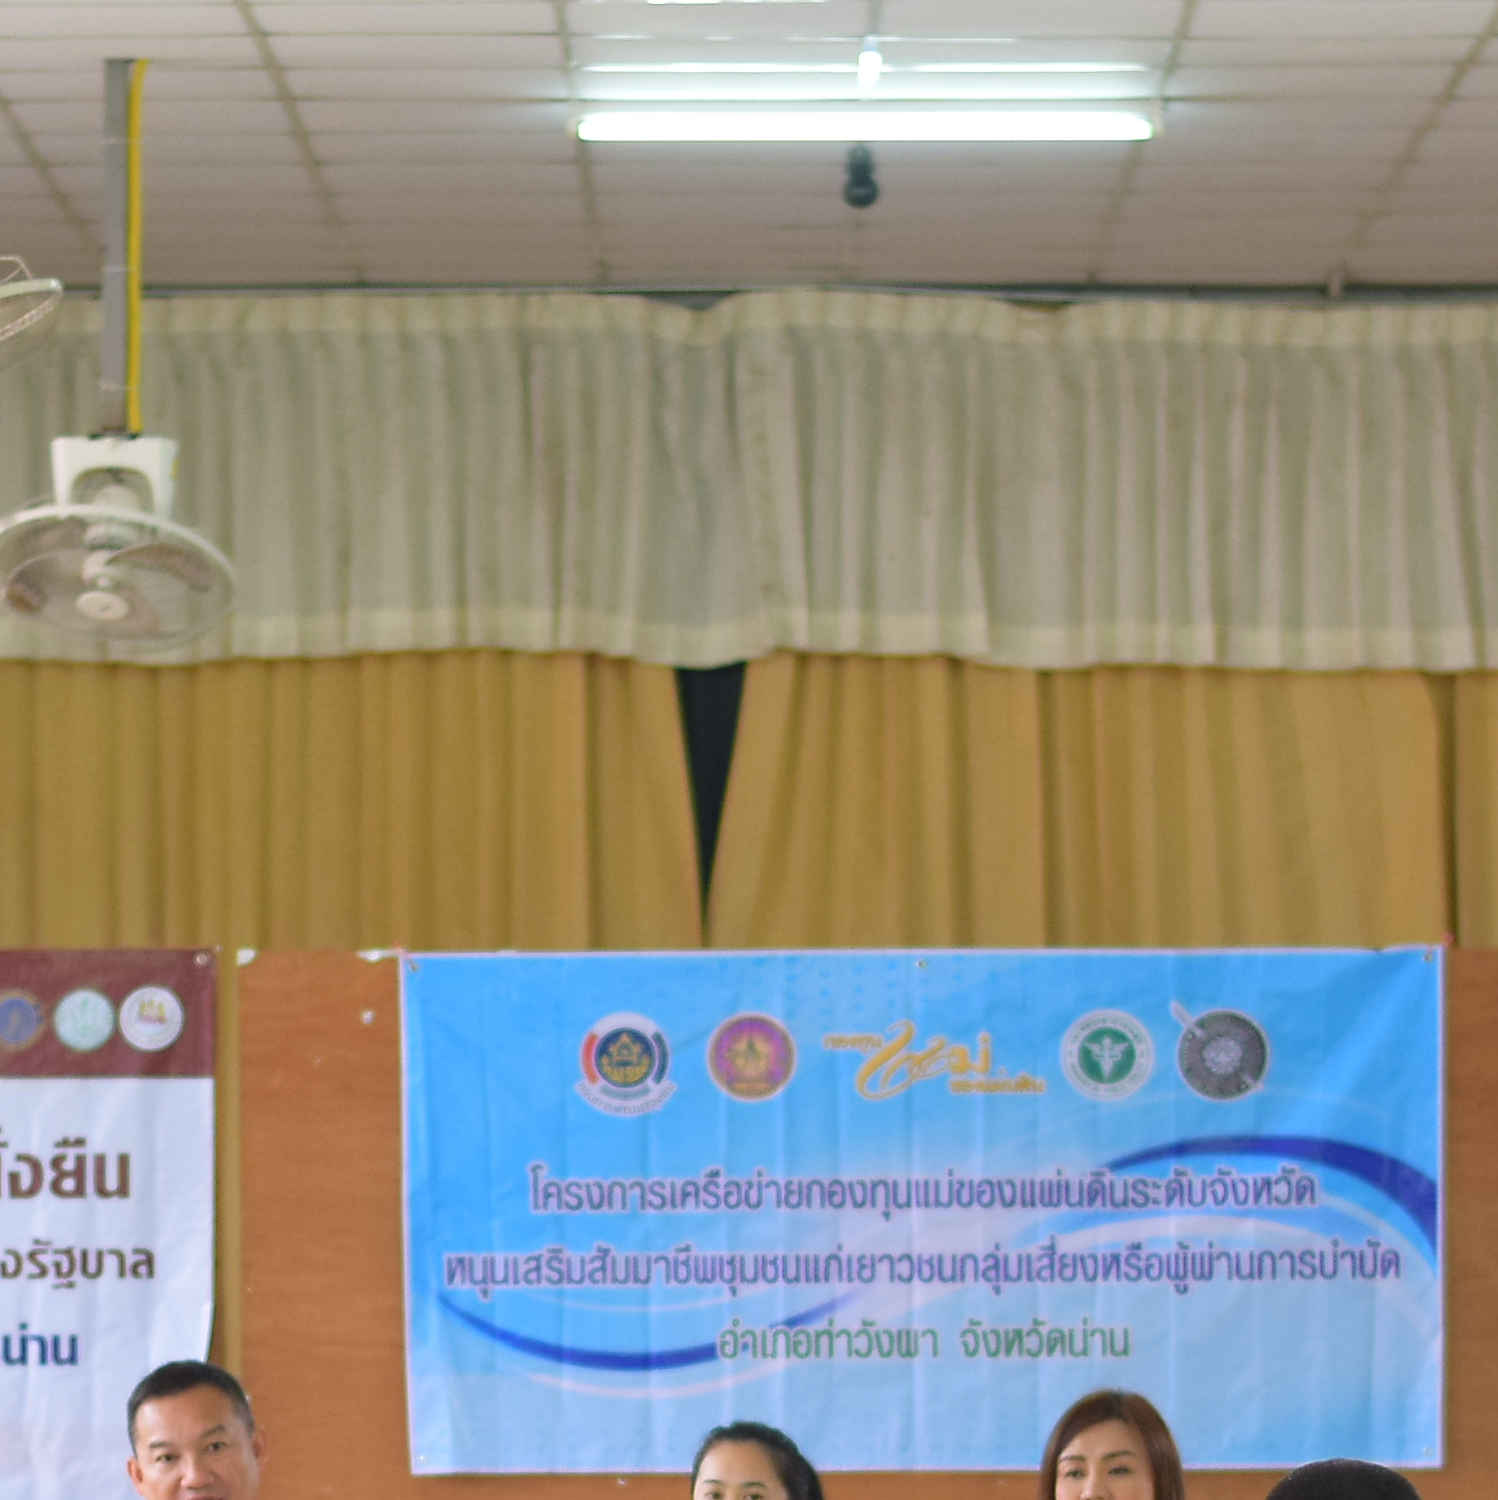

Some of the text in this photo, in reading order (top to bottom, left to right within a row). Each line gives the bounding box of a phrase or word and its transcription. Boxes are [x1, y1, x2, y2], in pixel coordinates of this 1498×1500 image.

[531, 1164, 1316, 1221] โครงการเครือข่ายกองทุนแม่ของแผ่นดินระดับจังหวัด
[446, 1236, 1400, 1298] หนุนเสริมสัมมาชีพชุมชนแก่เยาวชนกลุ่มเสี่ยงหรือผู้ผ่านการบำบัด
[718, 1317, 1131, 1359] อำเภอท่าวังผา จังหวัดน่าน
